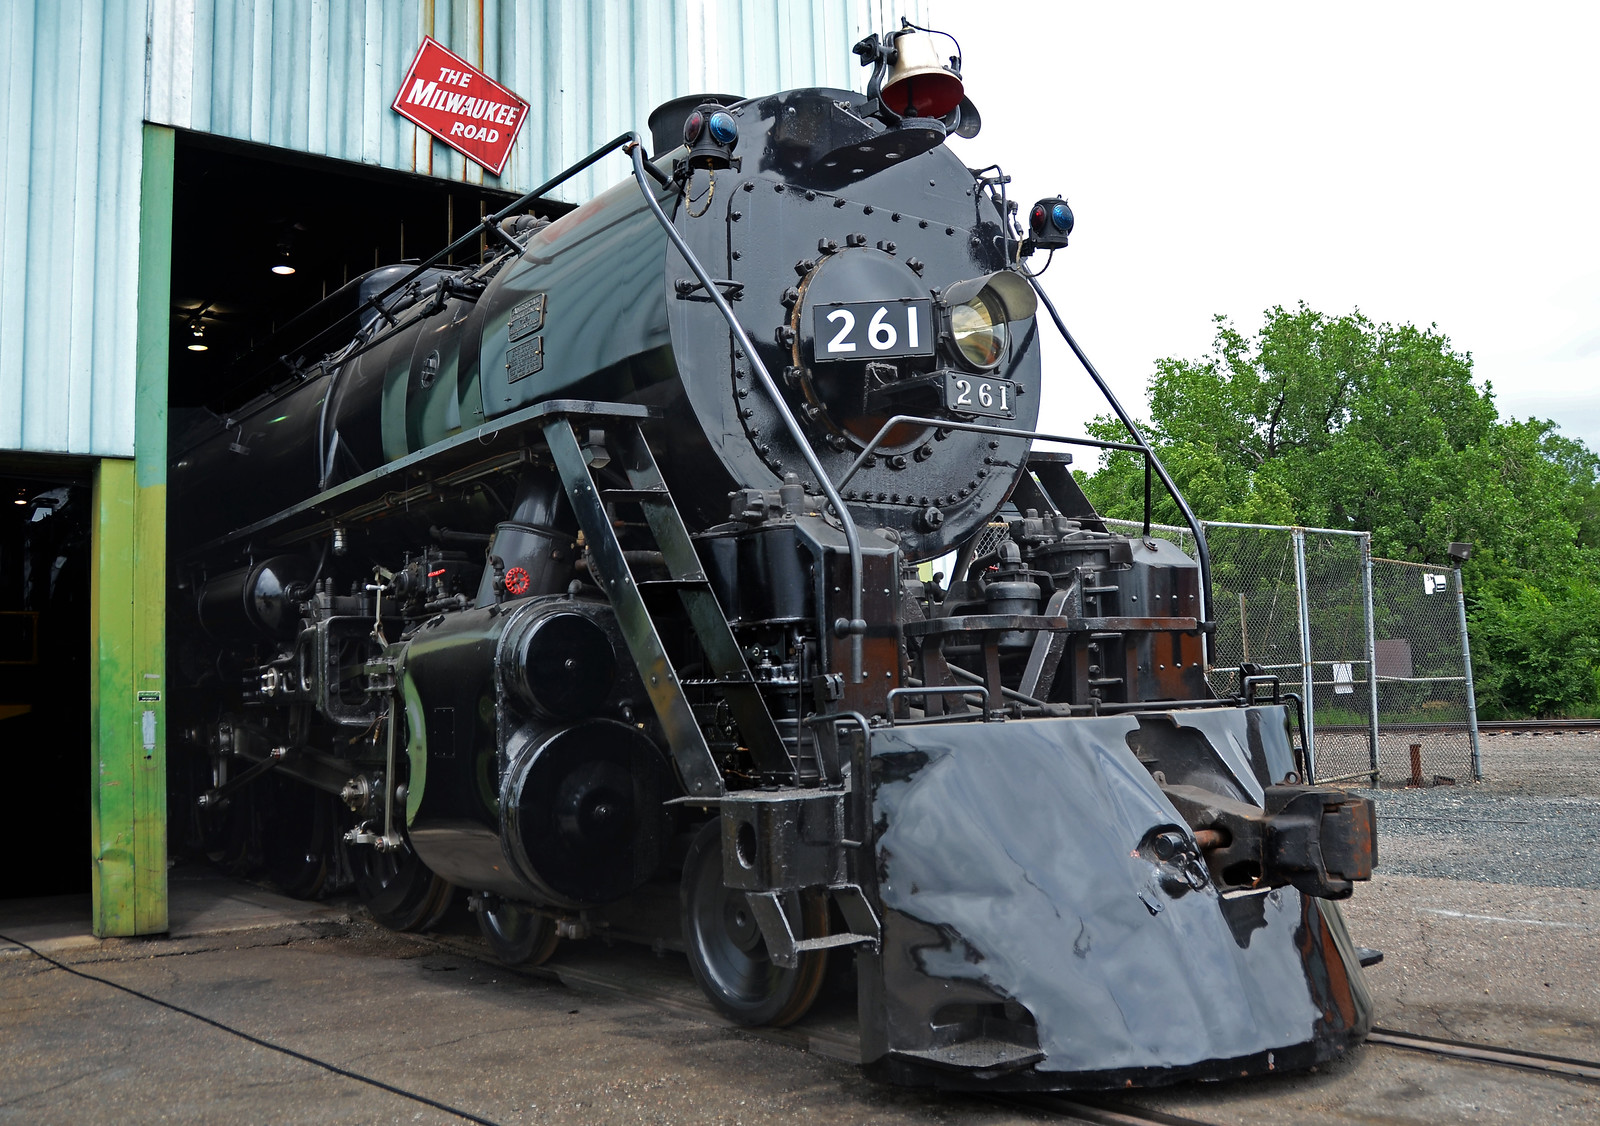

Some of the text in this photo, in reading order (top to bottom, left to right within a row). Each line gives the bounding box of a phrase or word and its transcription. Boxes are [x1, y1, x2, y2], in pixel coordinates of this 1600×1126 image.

[438, 67, 472, 88] THE
[406, 78, 520, 126] MILWAUKEE
[450, 121, 499, 143] ROAD
[826, 306, 919, 353] 261
[956, 379, 1009, 411] 261
